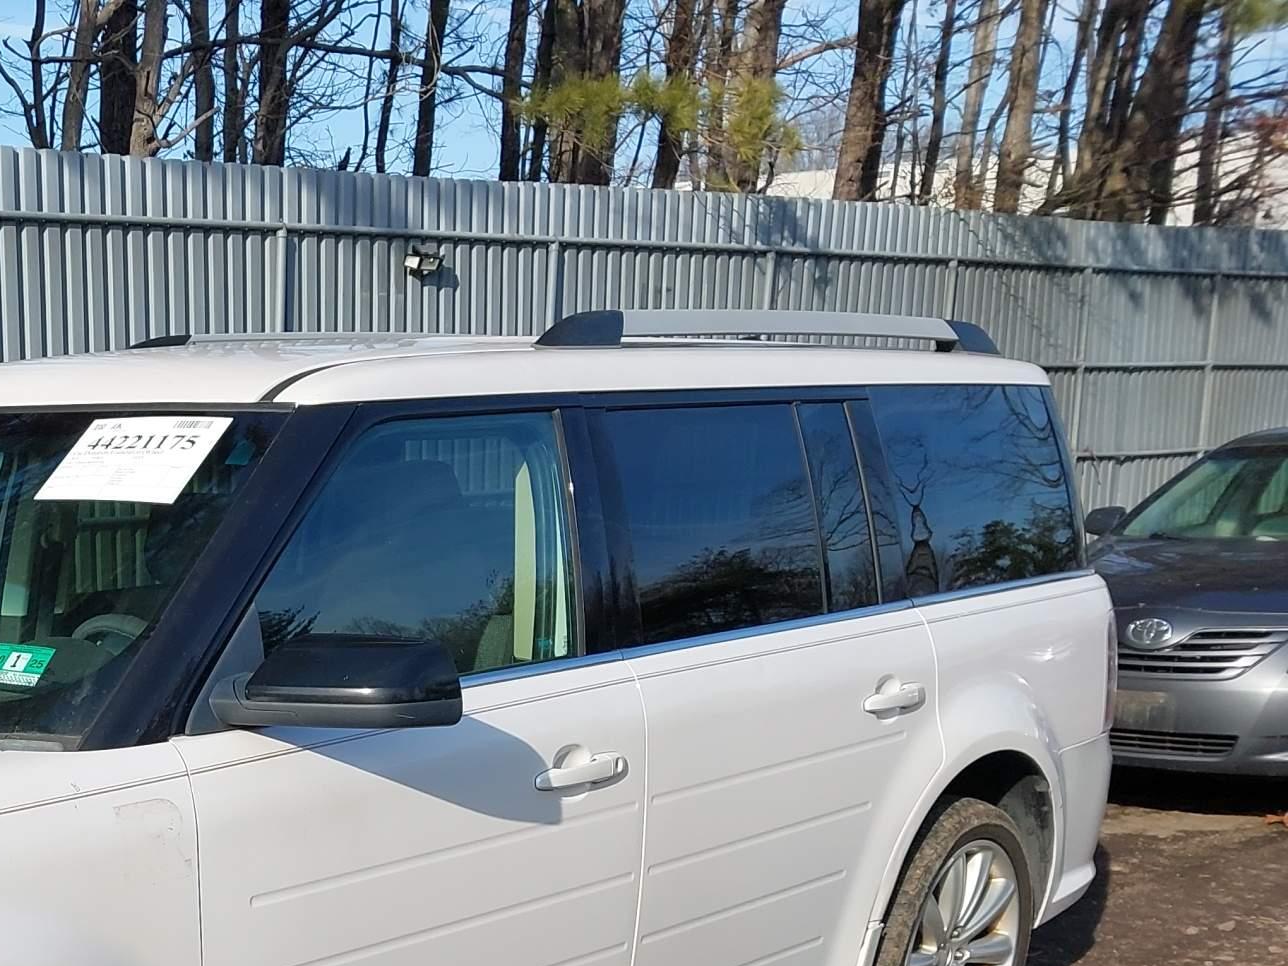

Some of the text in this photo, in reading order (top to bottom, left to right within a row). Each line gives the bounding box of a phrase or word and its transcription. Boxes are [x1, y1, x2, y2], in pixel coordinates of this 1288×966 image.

[87, 434, 201, 450] 44221175
[10, 654, 22, 668] 1
[30, 659, 45, 669] 25
